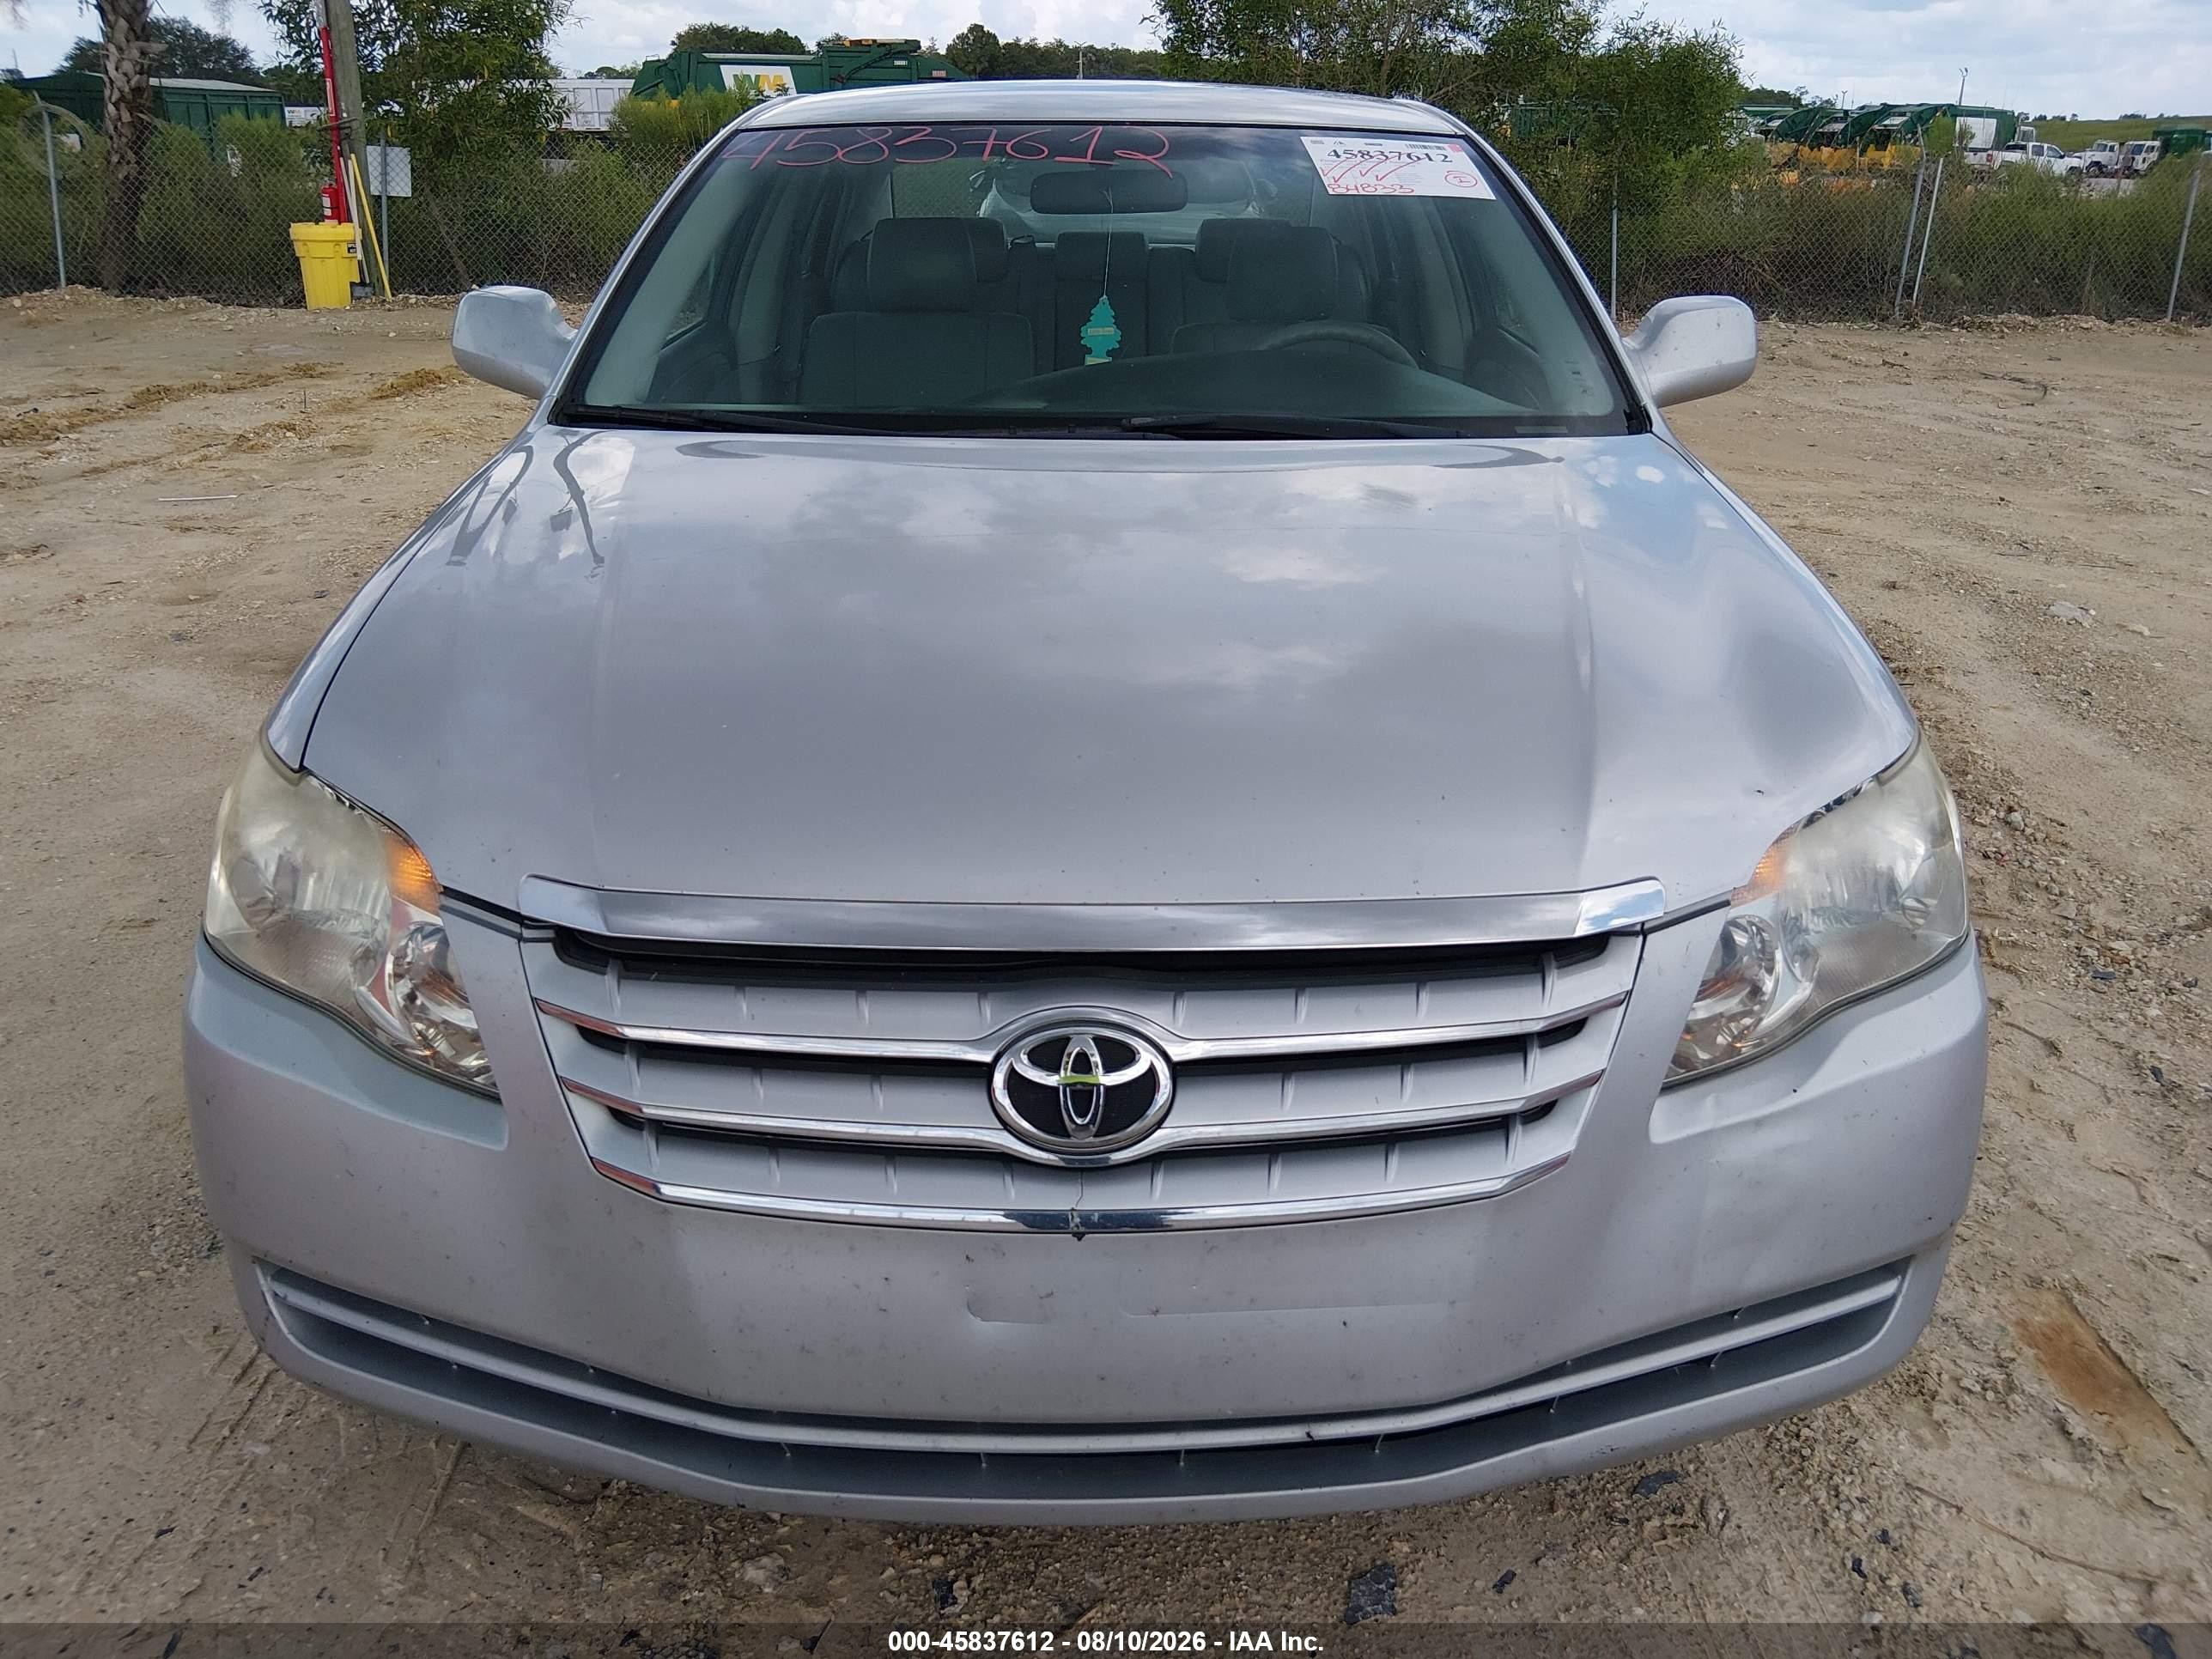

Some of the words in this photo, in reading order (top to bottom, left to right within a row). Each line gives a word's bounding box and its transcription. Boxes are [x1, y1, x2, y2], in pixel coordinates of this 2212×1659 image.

[732, 74, 783, 90] WM
[721, 125, 1173, 179] 45837612
[1327, 149, 1453, 163] 45837612
